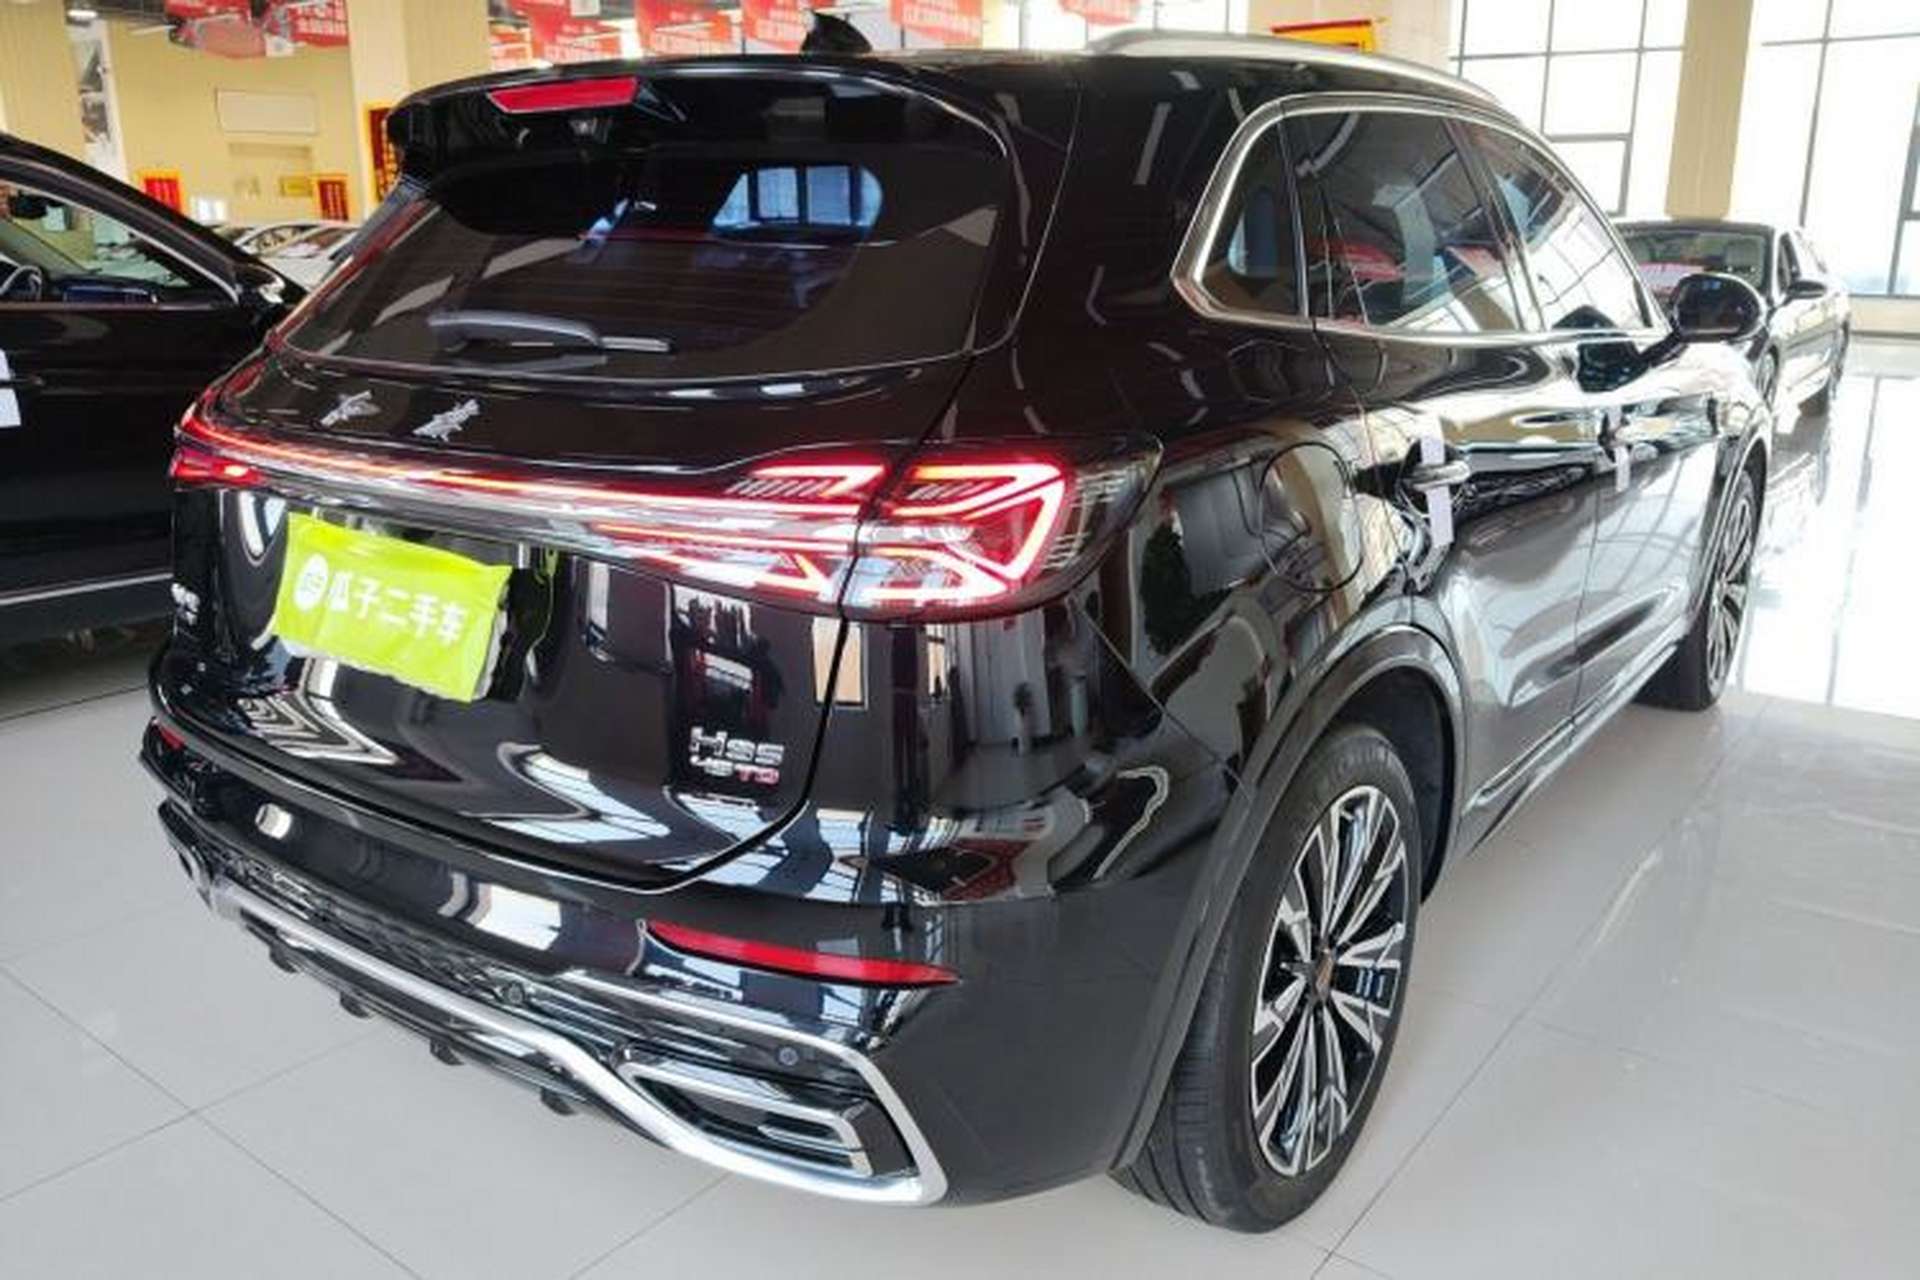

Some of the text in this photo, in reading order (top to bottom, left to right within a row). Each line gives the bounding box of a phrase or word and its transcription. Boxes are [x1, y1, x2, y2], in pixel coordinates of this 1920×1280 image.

[328, 570, 468, 645] 瓜子二手车
